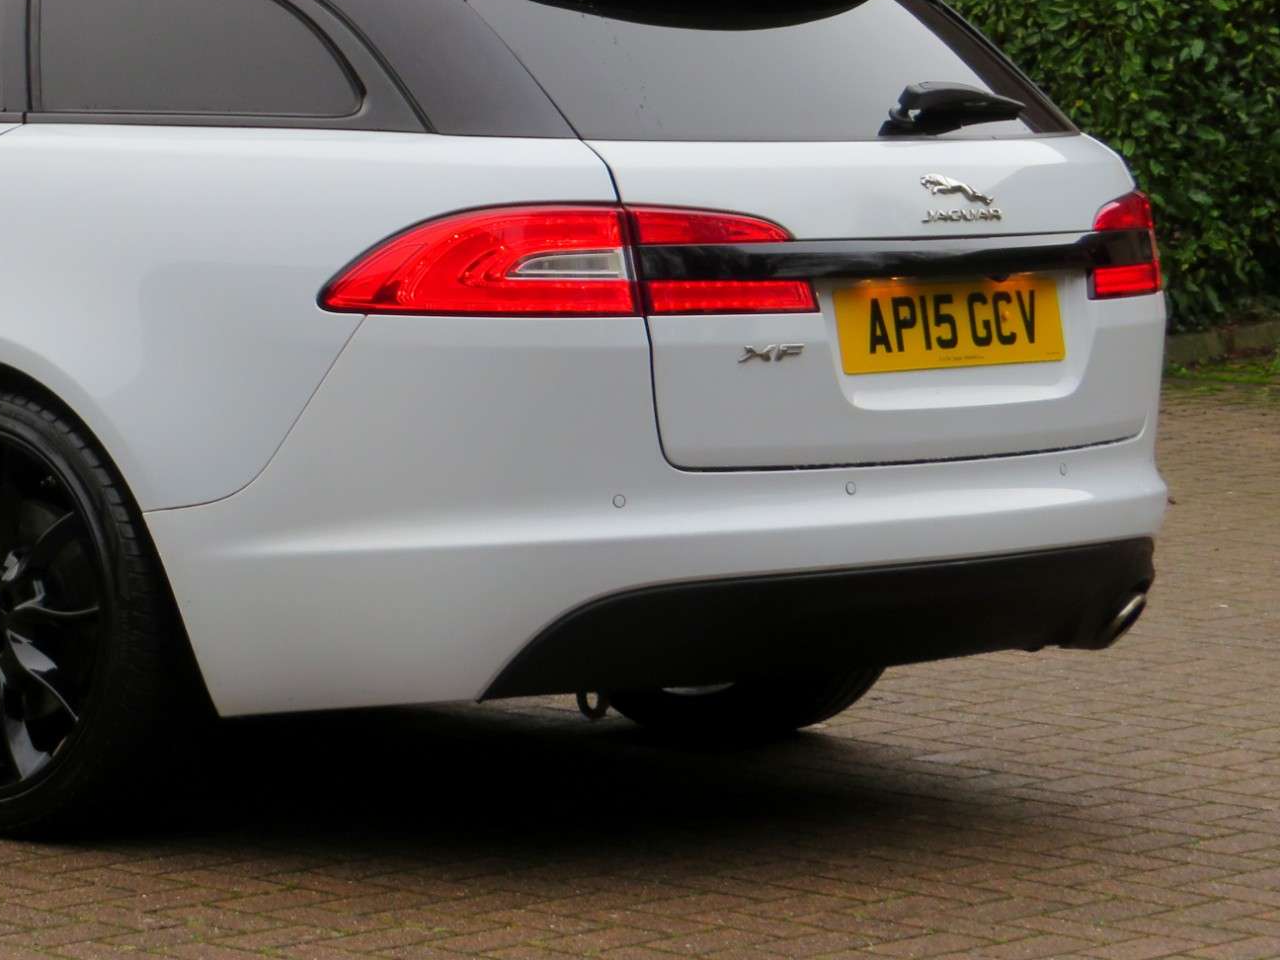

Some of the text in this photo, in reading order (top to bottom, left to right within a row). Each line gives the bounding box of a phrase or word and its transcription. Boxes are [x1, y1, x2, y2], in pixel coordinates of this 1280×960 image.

[921, 208, 1002, 224] JAGUAR
[868, 289, 1036, 355] AP15 GCV
[736, 343, 806, 364] XF
